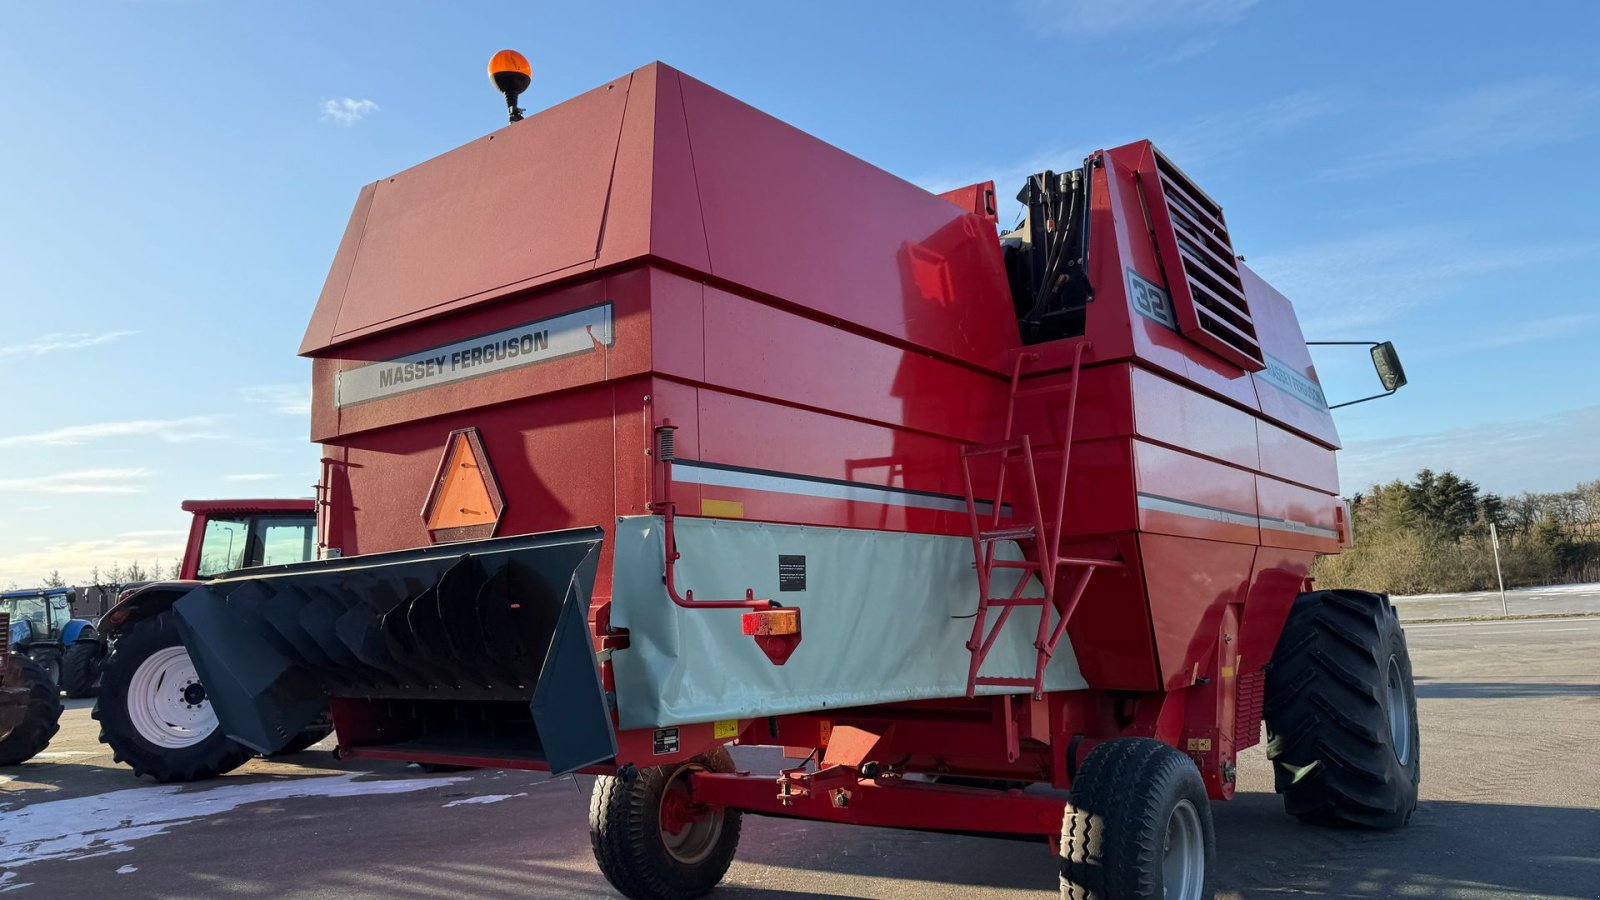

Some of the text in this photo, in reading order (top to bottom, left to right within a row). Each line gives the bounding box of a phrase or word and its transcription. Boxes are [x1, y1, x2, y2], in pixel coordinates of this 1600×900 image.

[1132, 278, 1168, 322] 32
[379, 330, 549, 388] MASSEY FERGUSON
